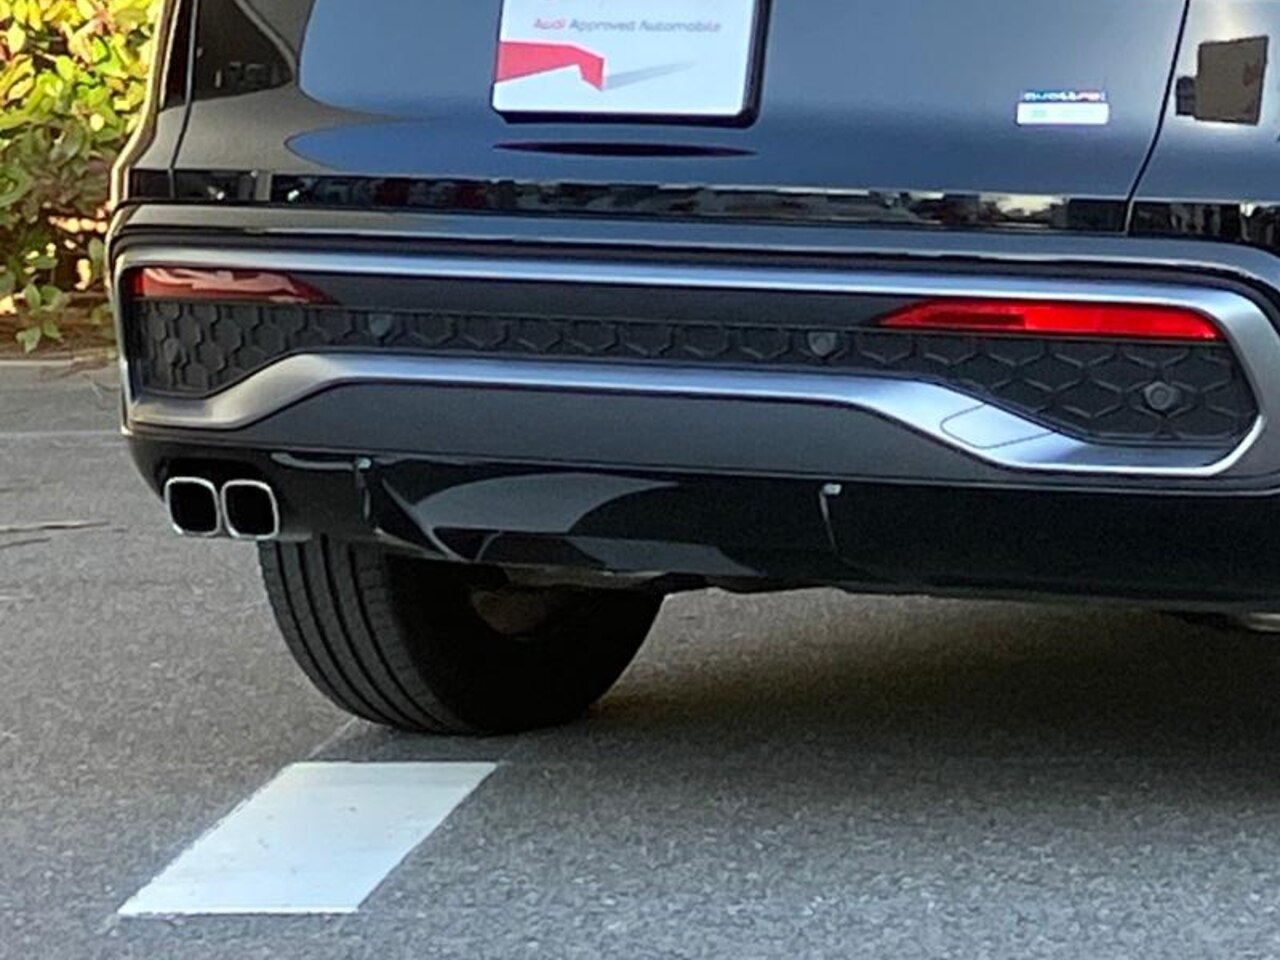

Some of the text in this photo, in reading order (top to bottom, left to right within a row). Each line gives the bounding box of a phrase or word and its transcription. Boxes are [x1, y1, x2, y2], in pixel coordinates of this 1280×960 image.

[532, 18, 721, 34] Audi Approved Automobile
